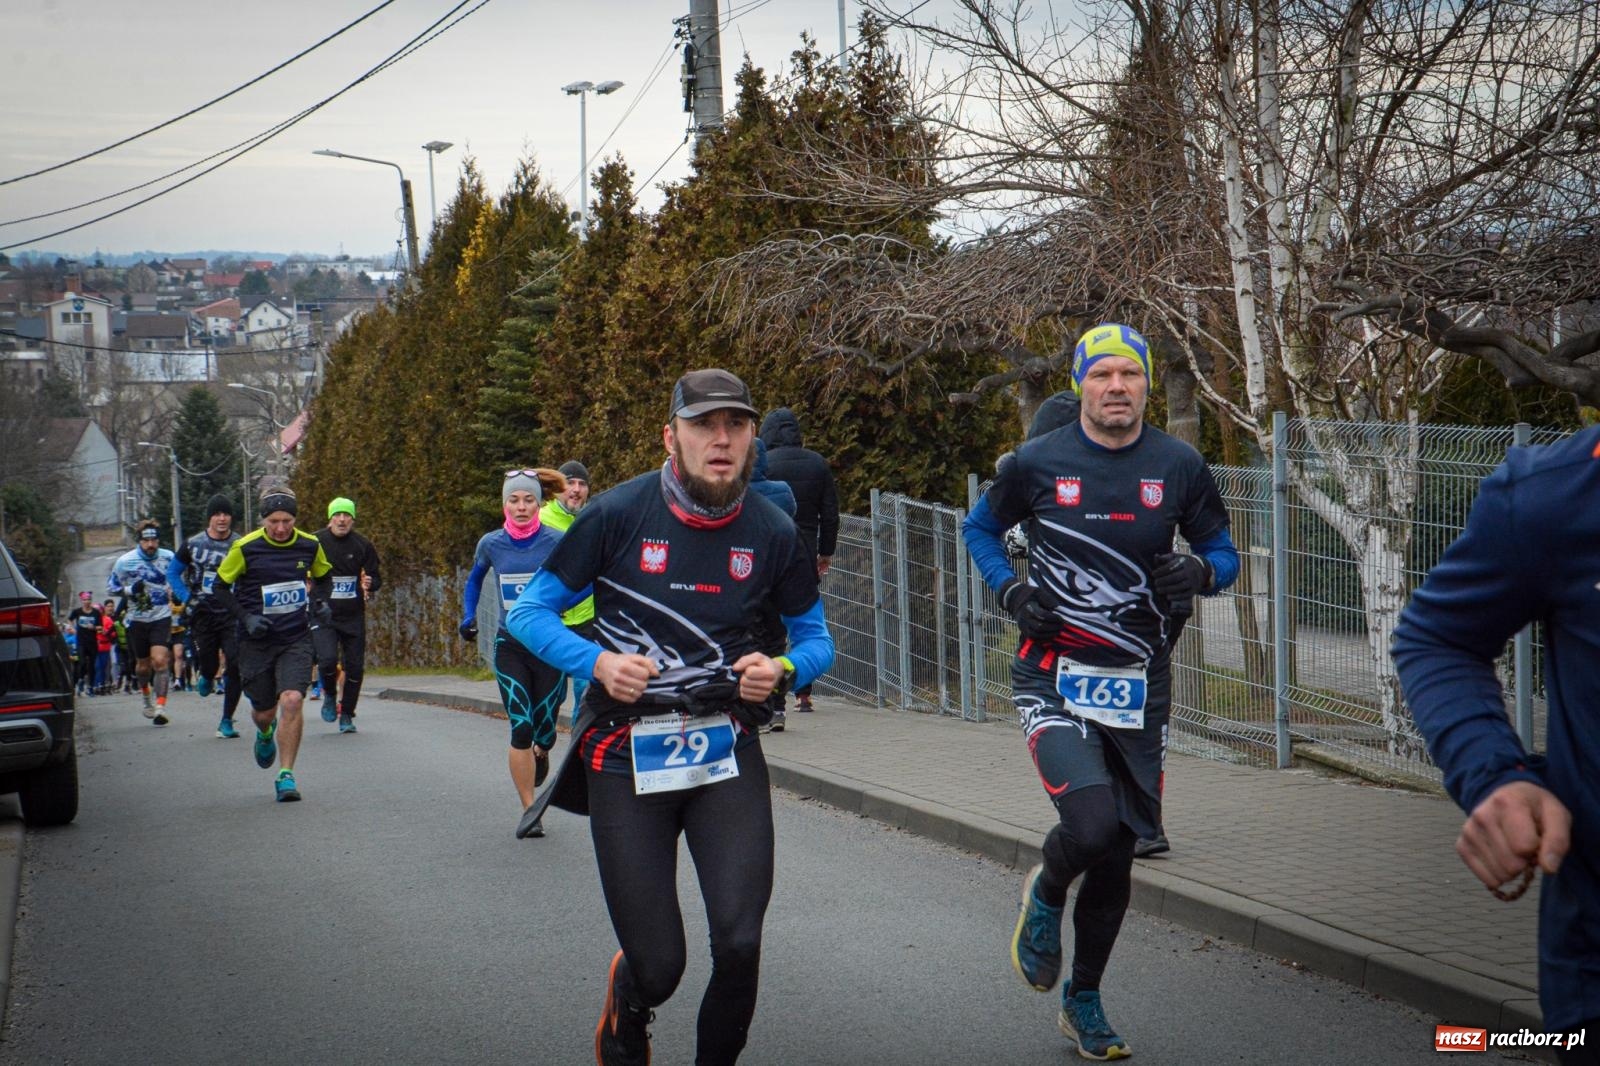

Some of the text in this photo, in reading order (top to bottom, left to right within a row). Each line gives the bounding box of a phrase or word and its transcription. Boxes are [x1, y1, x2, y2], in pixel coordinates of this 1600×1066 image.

[642, 537, 669, 545] POLSKA
[333, 582, 353, 592] 187
[271, 590, 300, 606] 200
[1074, 677, 1132, 708] 163
[663, 731, 710, 767] 29
